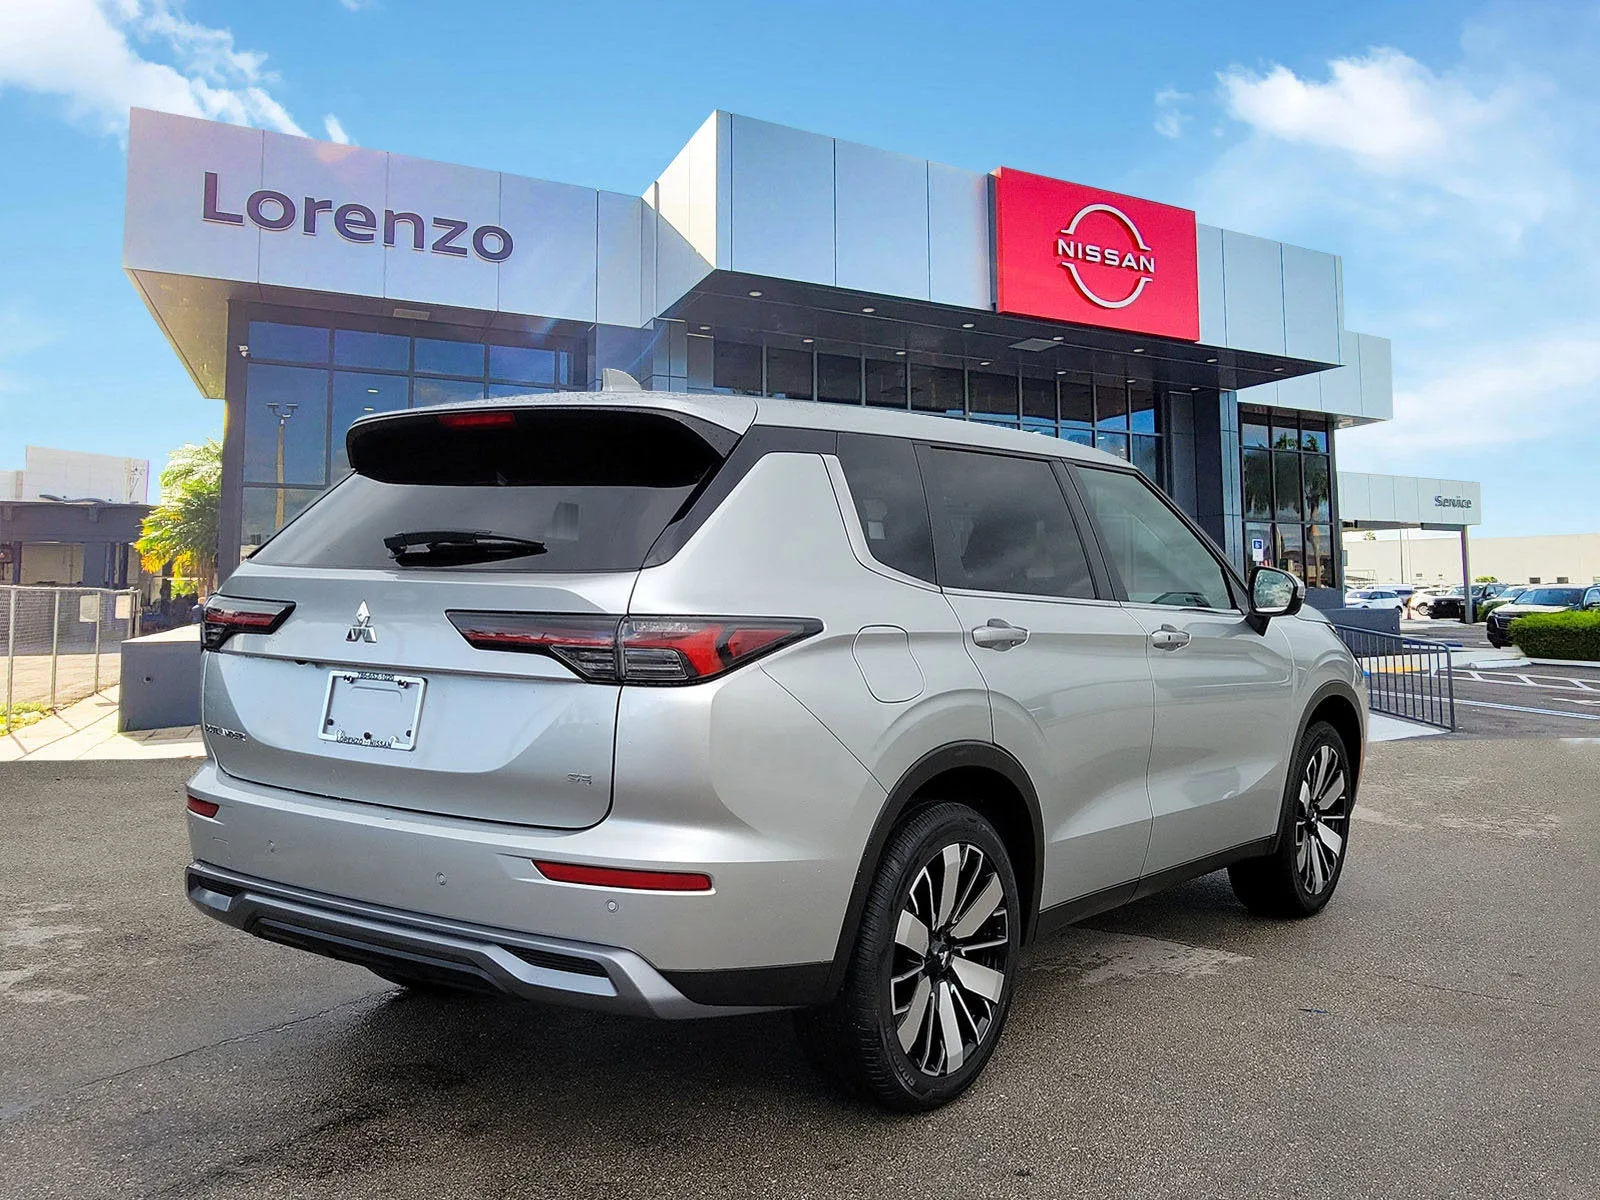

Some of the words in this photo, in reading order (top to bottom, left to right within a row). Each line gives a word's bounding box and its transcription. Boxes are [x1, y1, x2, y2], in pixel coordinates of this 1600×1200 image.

[203, 171, 514, 262] Lorenzo
[1057, 238, 1155, 274] NISSAN
[1434, 495, 1472, 509] Service
